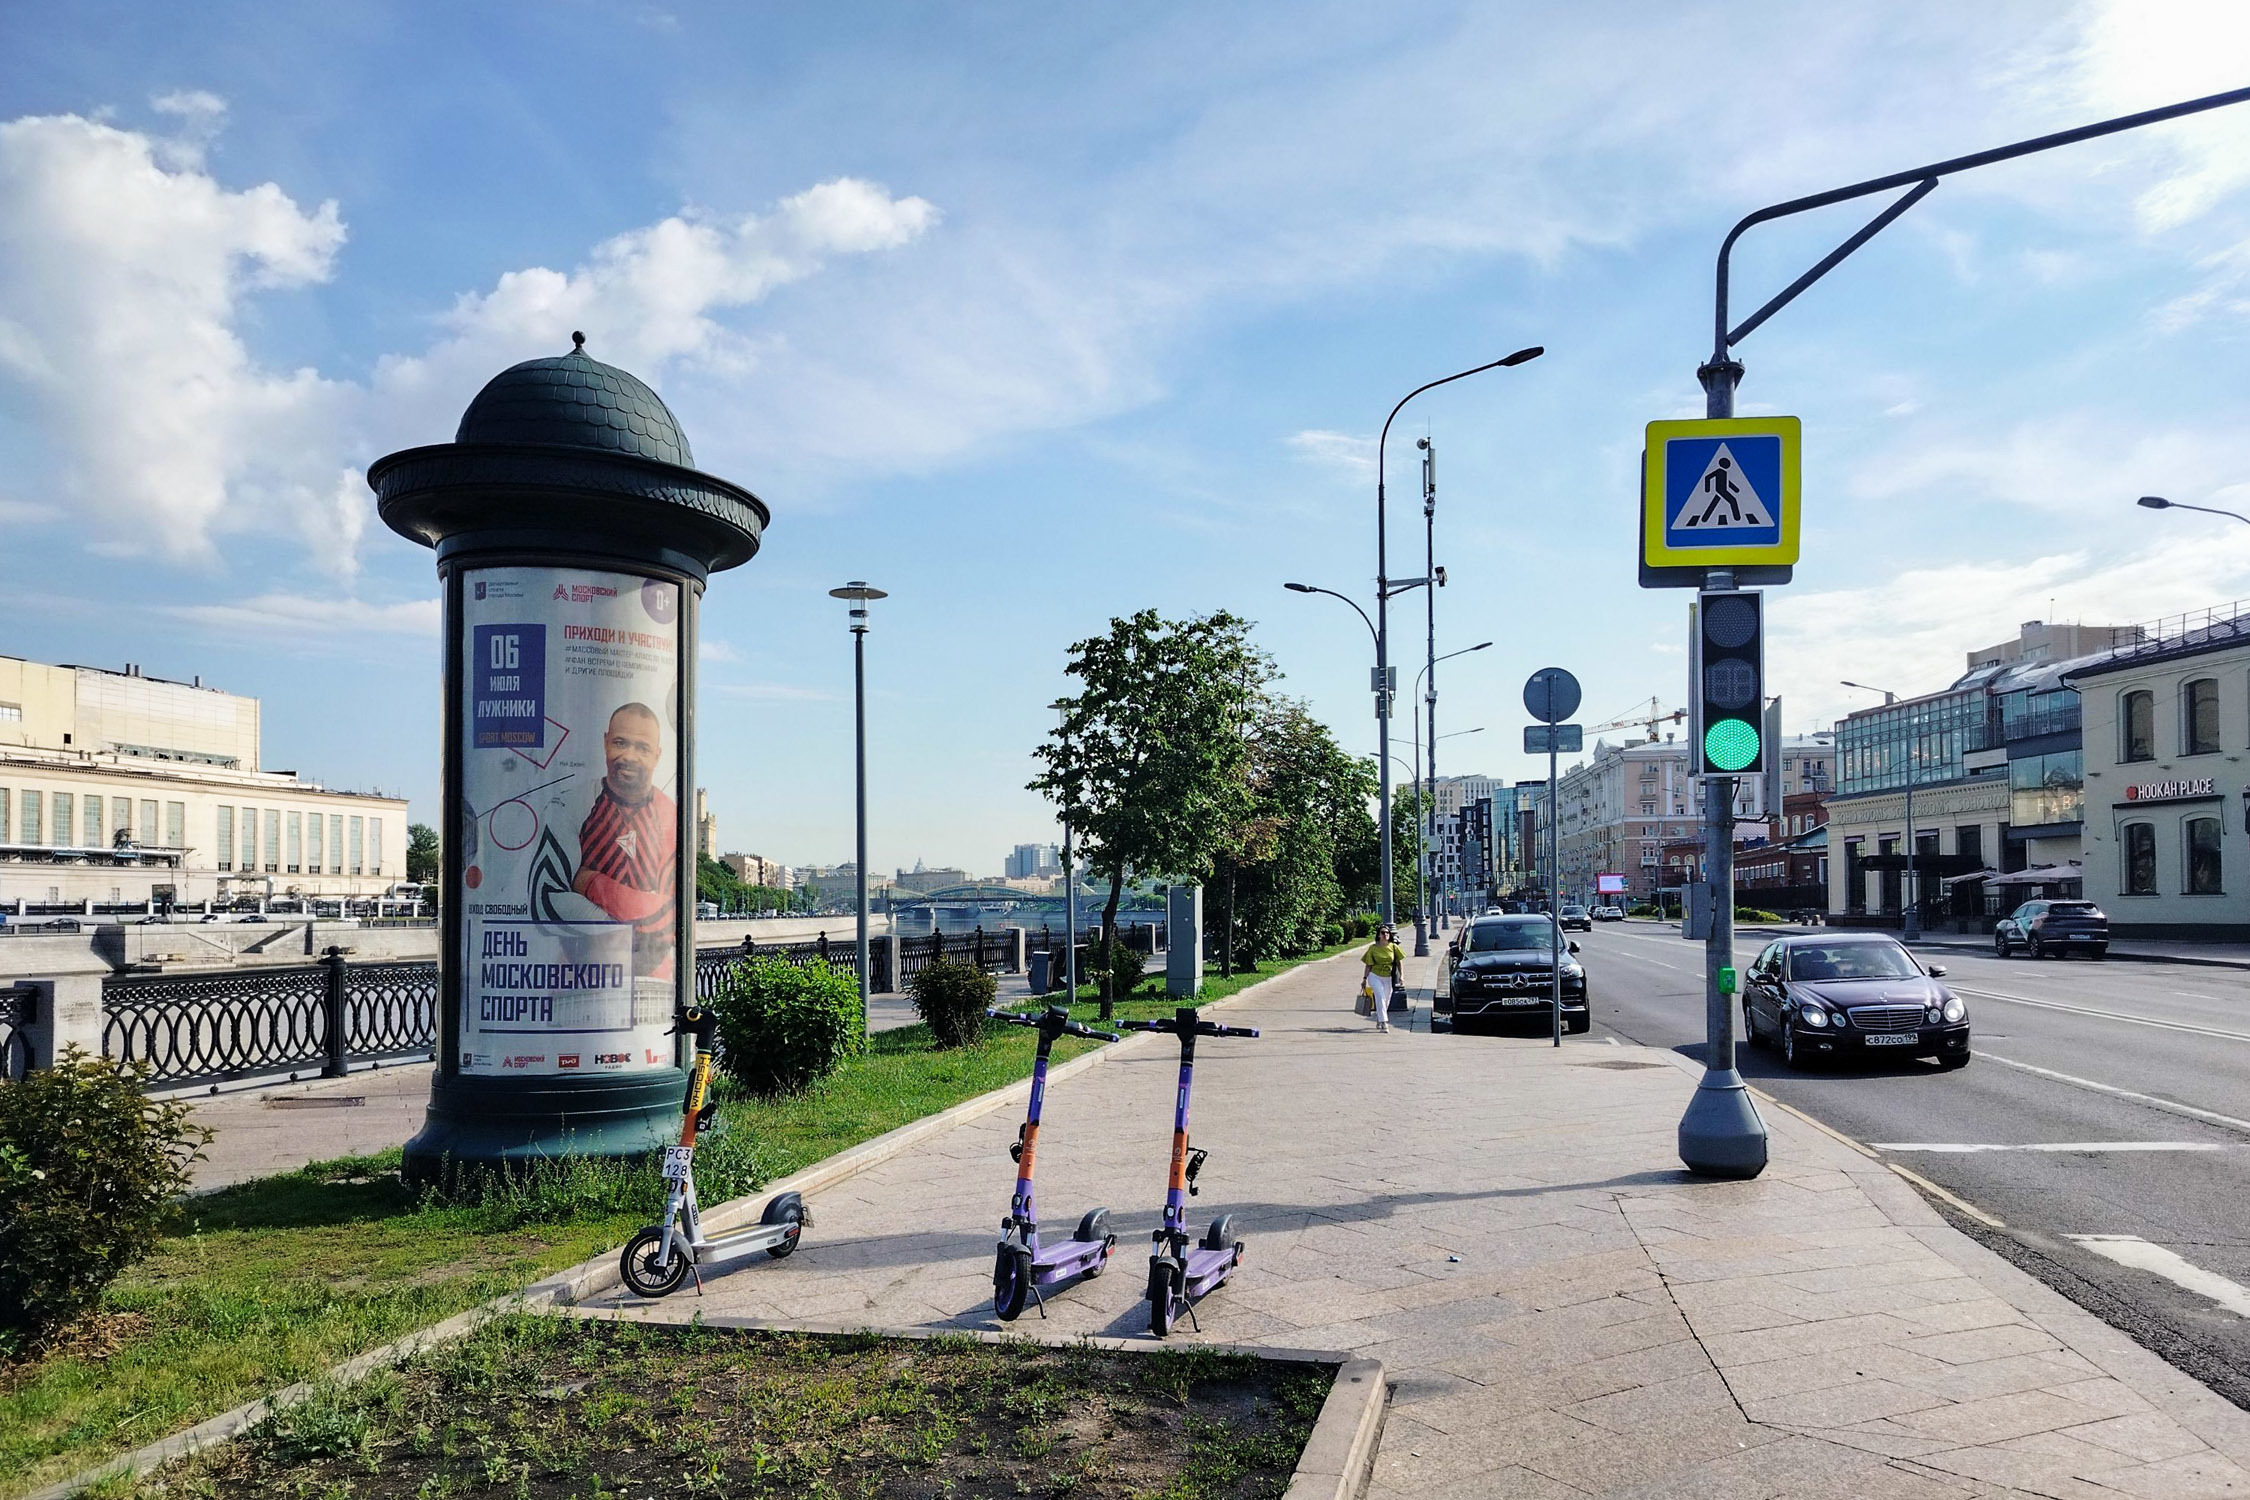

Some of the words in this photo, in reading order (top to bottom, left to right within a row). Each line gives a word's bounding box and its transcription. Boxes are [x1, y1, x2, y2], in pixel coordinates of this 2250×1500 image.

[571, 584, 618, 598] МОСКОВСКИЙ
[571, 593, 594, 603] СПОРТ
[656, 589, 671, 611] 0+
[564, 625, 615, 644] ПРИХОДИ
[618, 630, 625, 644] И
[490, 634, 520, 670] 06
[571, 667, 596, 676] ДРУГИЕ
[587, 657, 615, 667] ВСТРЕЧИ
[489, 675, 520, 692] ИЮЛЯ
[477, 699, 536, 718] ЛУЖНИКИ
[2138, 782, 2178, 800] HOOKAH
[2180, 778, 2213, 796] PLACE
[1836, 813, 1858, 824] SOHO
[1859, 807, 1888, 822] ROOMS
[1890, 804, 1916, 818] SOHO
[1917, 801, 1950, 816] ROOMS
[1958, 798, 1983, 811] SOHO
[468, 904, 484, 915] ВХОД
[485, 903, 528, 916] СВОБОДНЫЙ
[481, 931, 528, 960] ДЕНЬ
[481, 963, 624, 990] МОСКОВСКОГО
[480, 995, 554, 1022] СПОРТА
[691, 1056, 707, 1108] WHOOSH
[665, 1164, 688, 1177] 128
